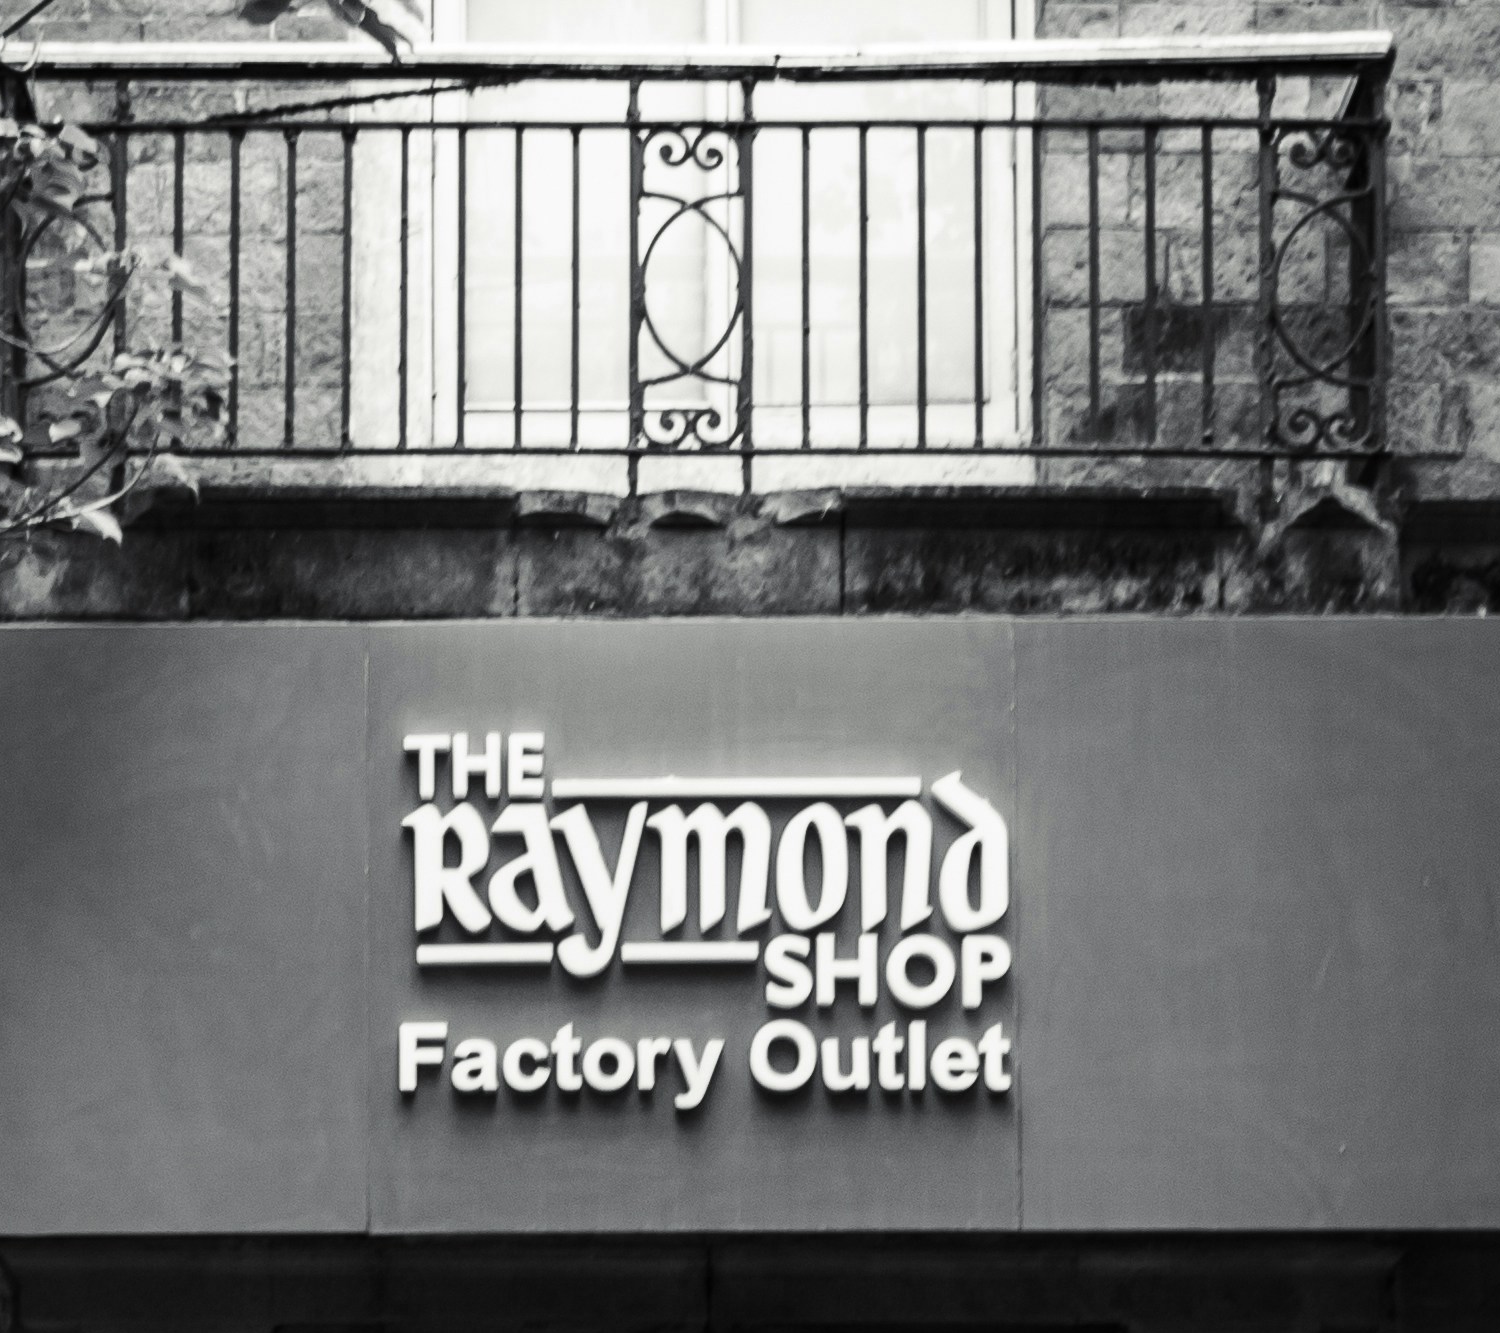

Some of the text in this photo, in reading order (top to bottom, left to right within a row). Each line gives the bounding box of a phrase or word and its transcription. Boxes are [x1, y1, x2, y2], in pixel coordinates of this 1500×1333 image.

[403, 731, 545, 799] THE
[401, 771, 1010, 977] Raymond
[763, 932, 1012, 1009] SHOP
[399, 1018, 1012, 1111] Factory Outlet
